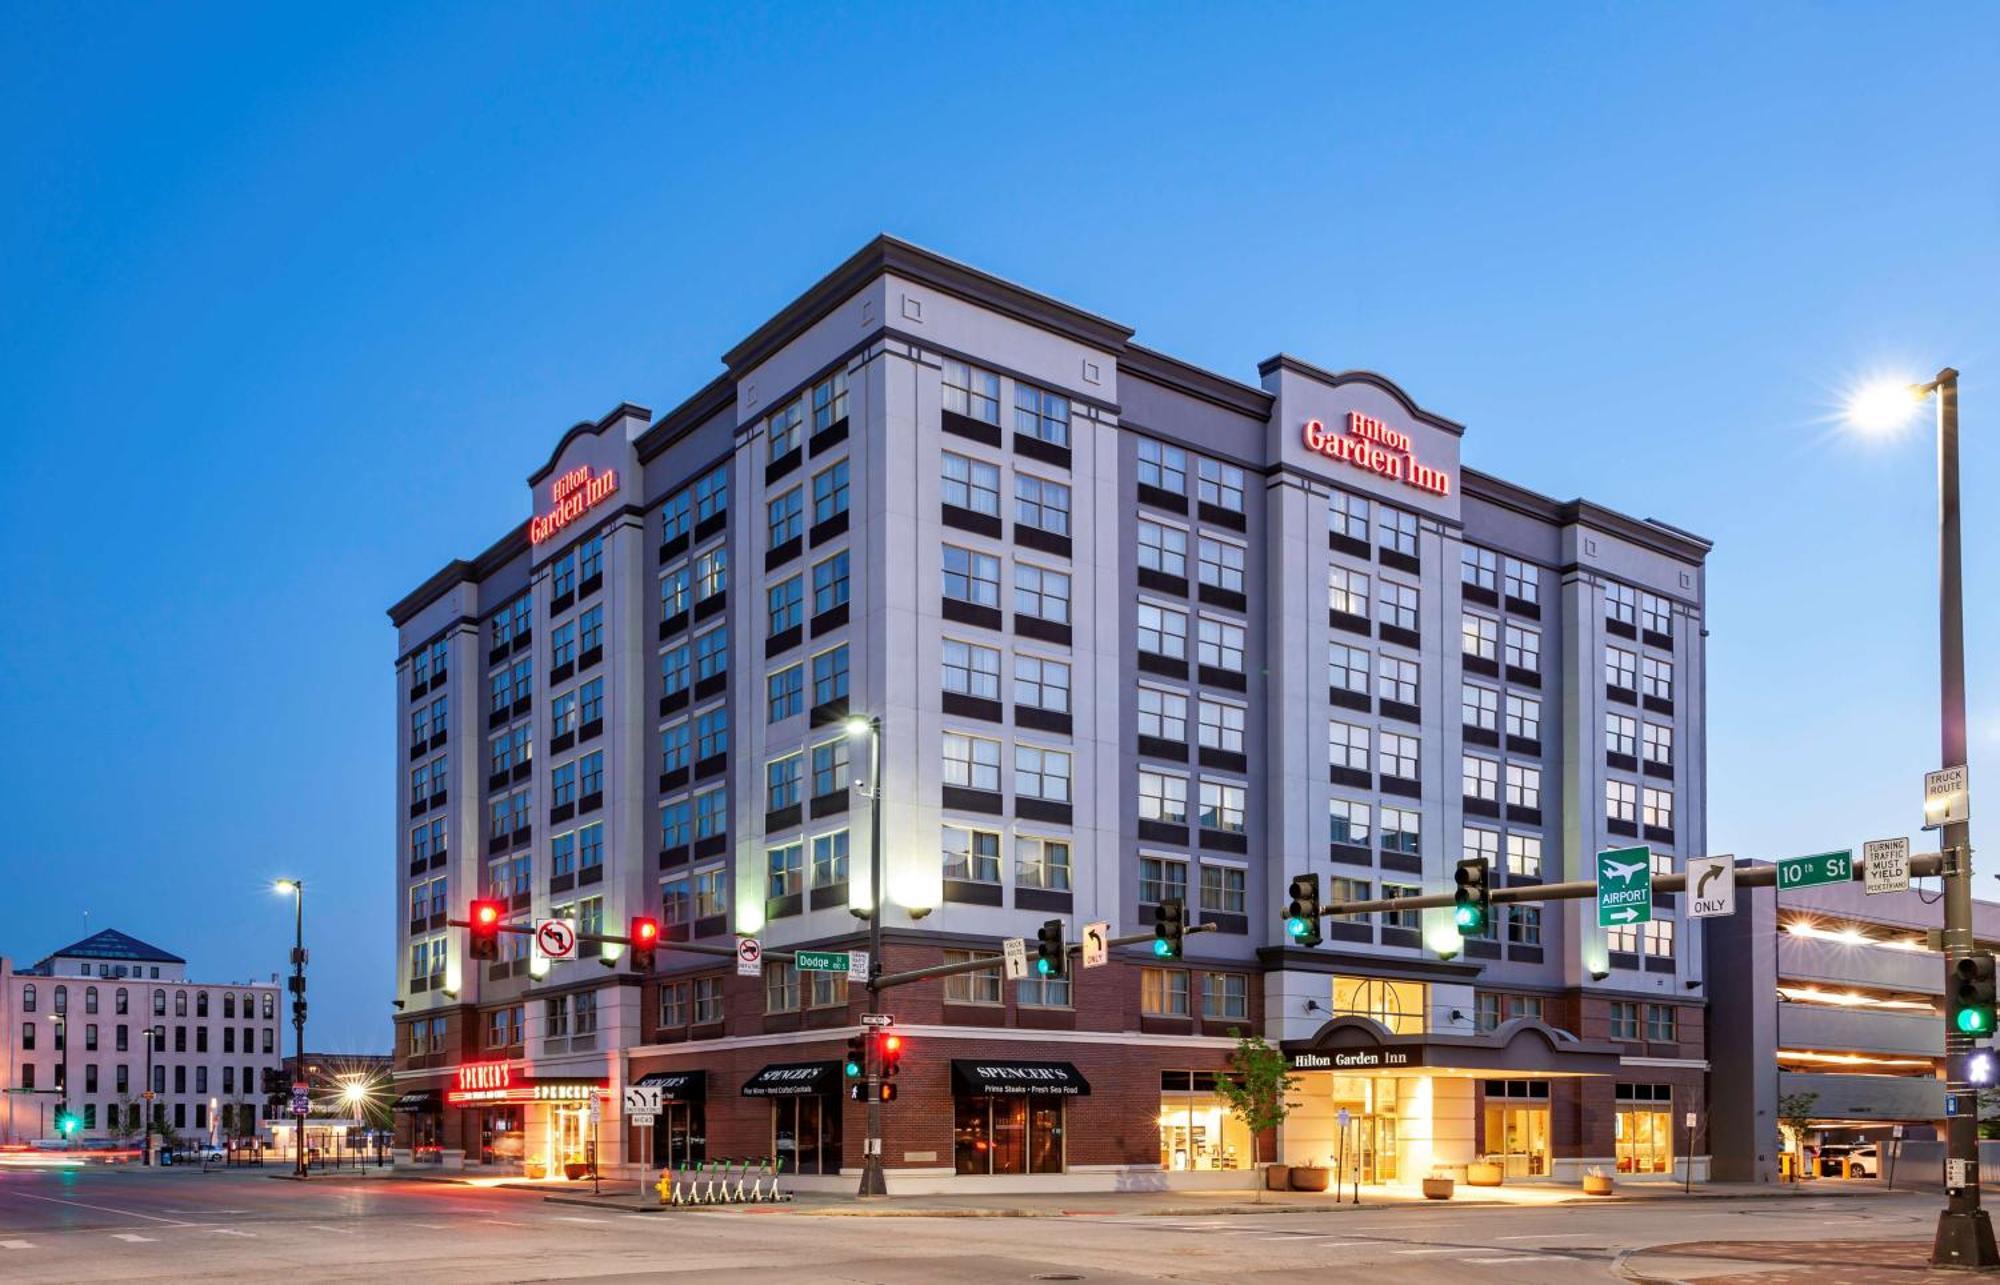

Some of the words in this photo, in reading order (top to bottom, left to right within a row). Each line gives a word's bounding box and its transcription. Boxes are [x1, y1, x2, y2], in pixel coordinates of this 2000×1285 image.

[1351, 411, 1410, 452] Hilton
[1307, 419, 1402, 479] Garden
[1408, 453, 1450, 495] Inn
[553, 465, 588, 502] Hilton
[530, 493, 583, 544] Garden
[586, 469, 613, 506] Inn
[1930, 771, 1961, 784] TRUCK
[1930, 781, 1962, 795] ROUTE
[1869, 841, 1904, 853] TURNING
[1870, 850, 1904, 861] TRAFFIC
[1826, 859, 1846, 877] St
[1873, 860, 1899, 870] MUST
[1871, 869, 1903, 878] YIELD
[1602, 889, 1648, 904] AIRPORT
[1694, 900, 1726, 913] ONLY
[800, 955, 828, 969] Dodge
[1295, 1054, 1330, 1067] Hilton
[1336, 1051, 1378, 1065] Garden
[1385, 1052, 1407, 1063] Inn
[460, 1063, 509, 1089] SPENCER'S
[976, 1066, 1068, 1080] SPENCER'S
[984, 1085, 1003, 1093] Prime
[1063, 1086, 1078, 1094] Food
